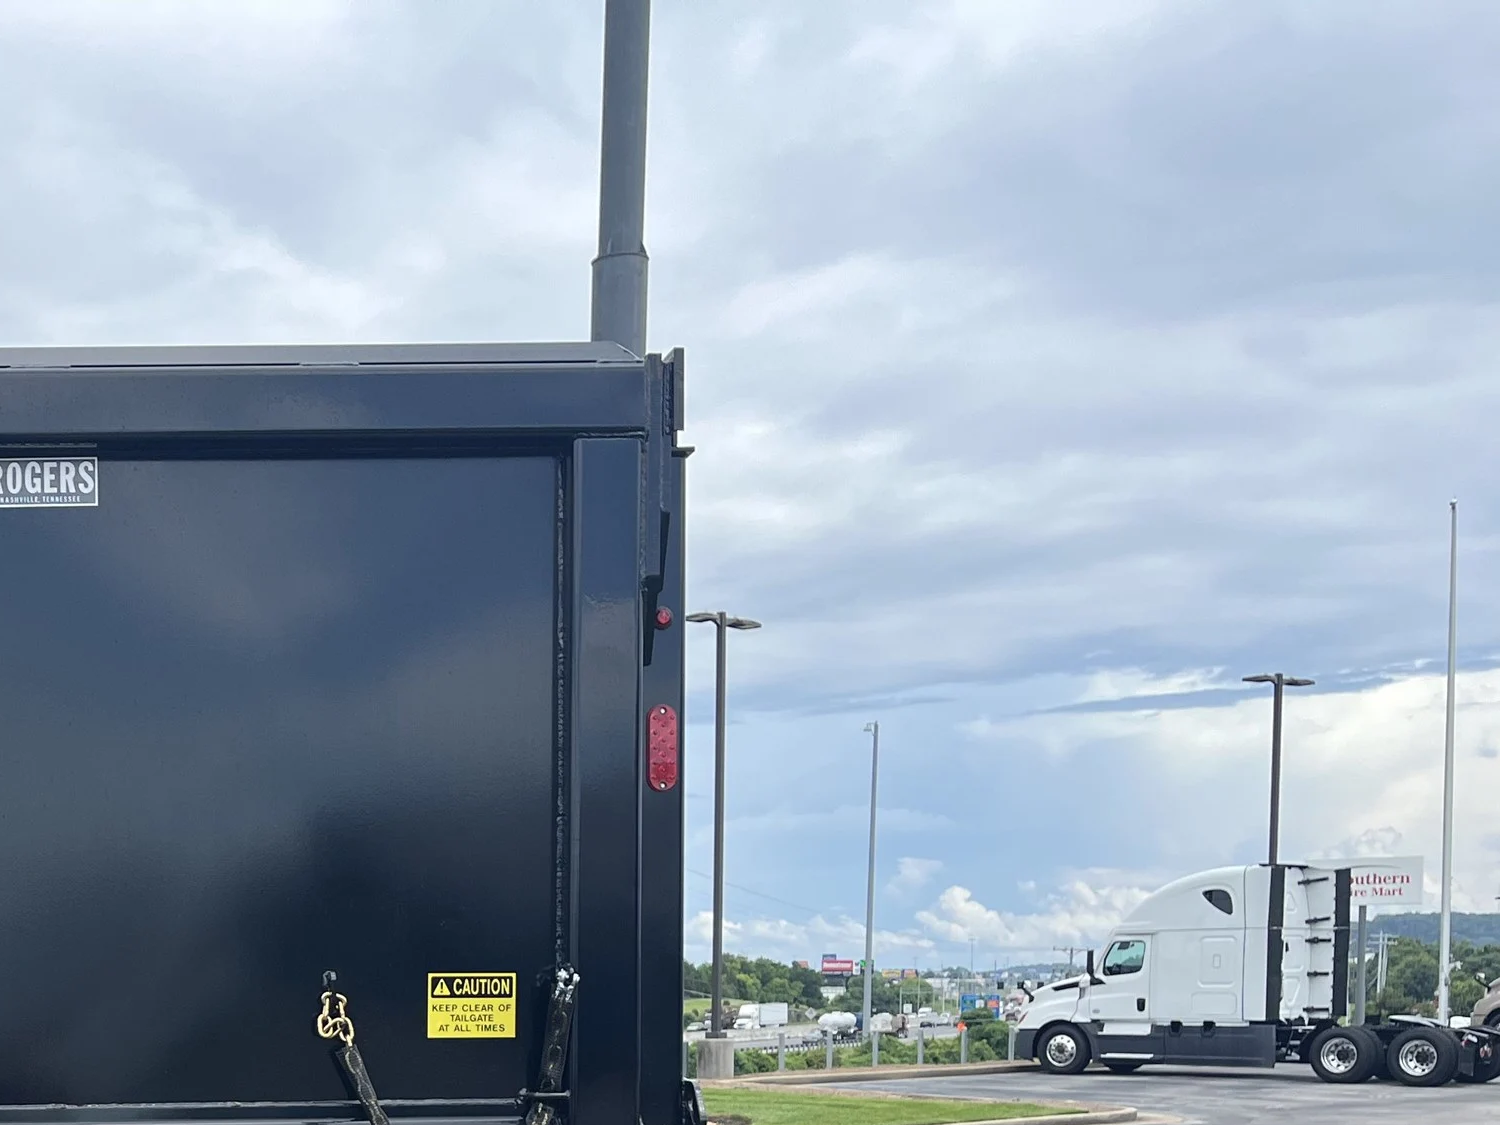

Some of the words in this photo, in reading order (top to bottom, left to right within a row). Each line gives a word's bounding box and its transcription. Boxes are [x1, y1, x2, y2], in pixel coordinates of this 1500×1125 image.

[1349, 873, 1410, 885] outhern
[1372, 887, 1403, 897] Mart
[453, 978, 510, 995] CAUTION
[432, 1004, 458, 1012] KEEP
[462, 1004, 494, 1012] CLEAR
[498, 1004, 512, 1012] OF
[450, 1014, 494, 1022] TAILGATE
[439, 1024, 449, 1032] AT
[454, 1024, 471, 1032] ALL
[476, 1024, 506, 1032] TIMES
